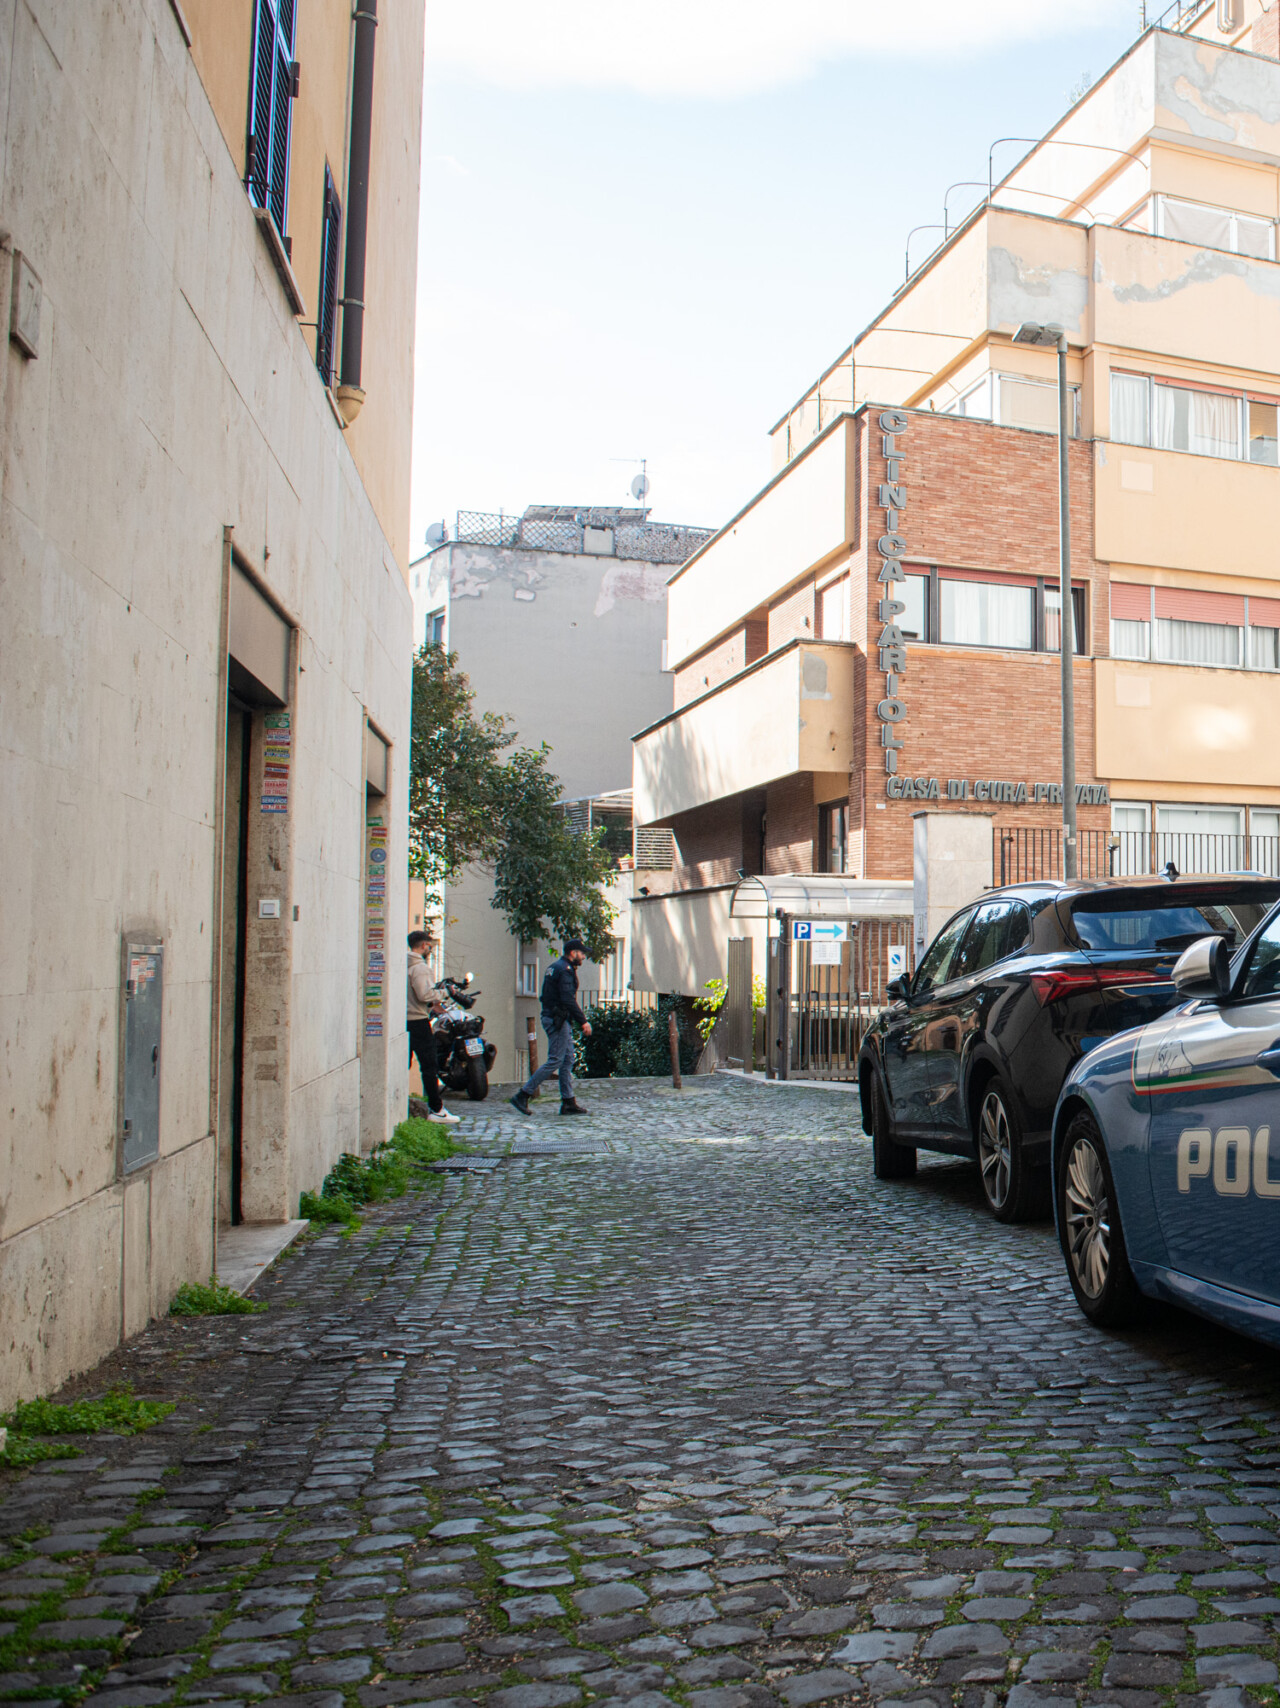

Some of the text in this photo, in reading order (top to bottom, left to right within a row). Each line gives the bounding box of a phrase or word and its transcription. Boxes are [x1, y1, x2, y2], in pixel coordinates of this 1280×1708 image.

[877, 410, 908, 774] CLINICA PARIOLI
[887, 776, 1110, 806] CASA DI CURA PRVATA
[797, 923, 809, 938] P
